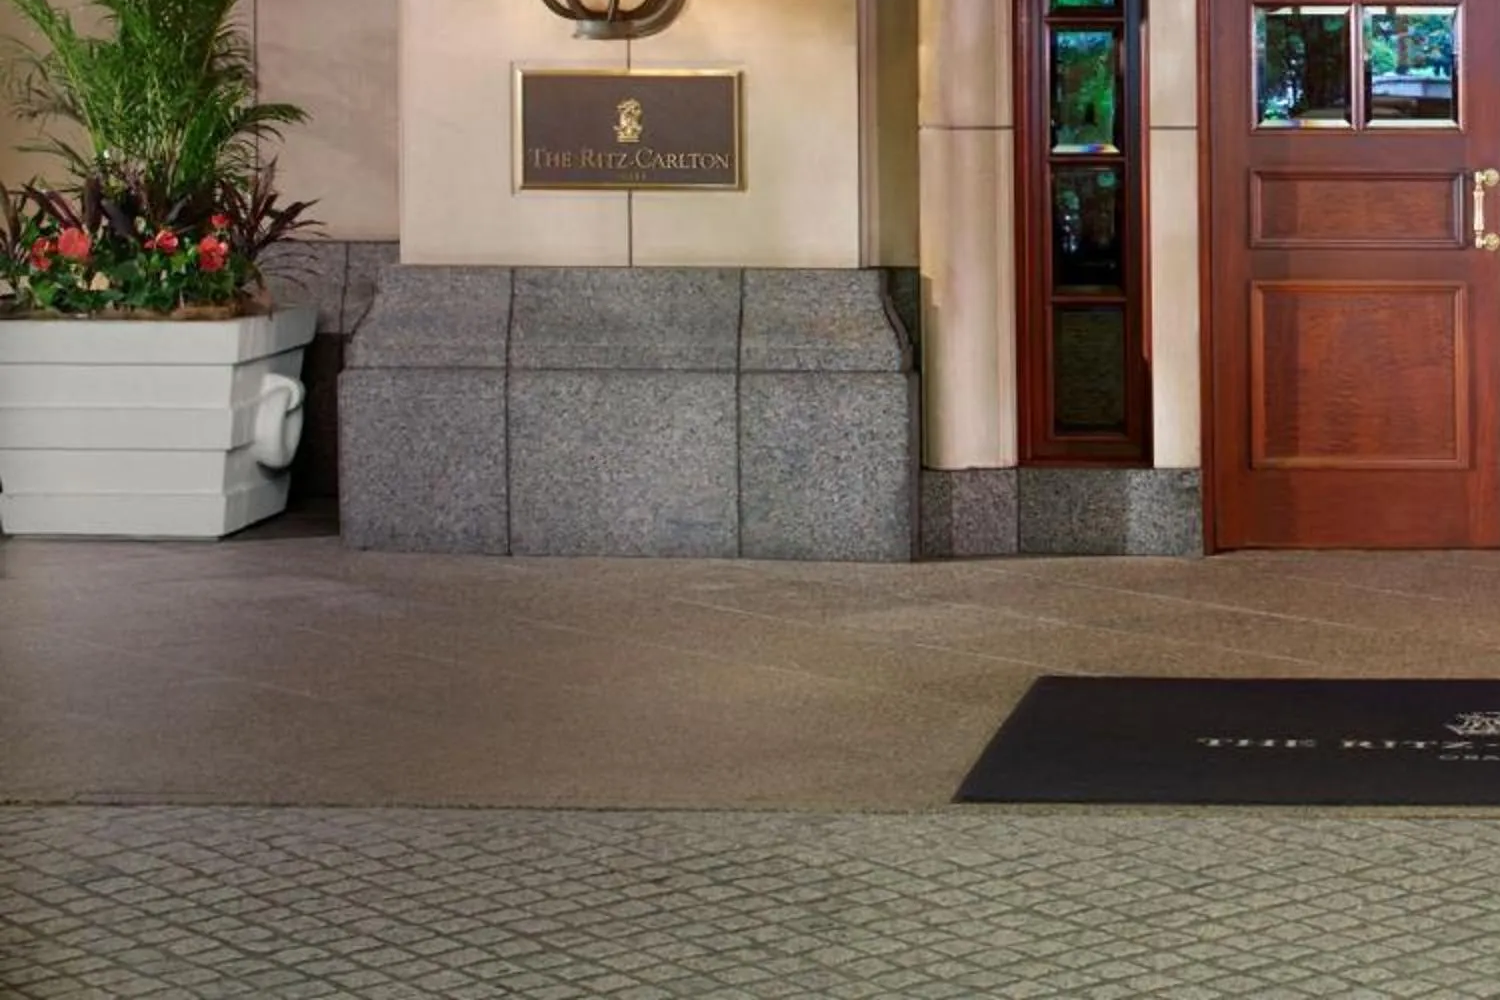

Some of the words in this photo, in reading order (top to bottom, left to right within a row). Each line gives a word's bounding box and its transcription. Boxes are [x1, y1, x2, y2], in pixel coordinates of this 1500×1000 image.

[530, 147, 572, 169] THE
[579, 147, 730, 170] RITZ-CARLTON
[1197, 737, 1316, 749] THE
